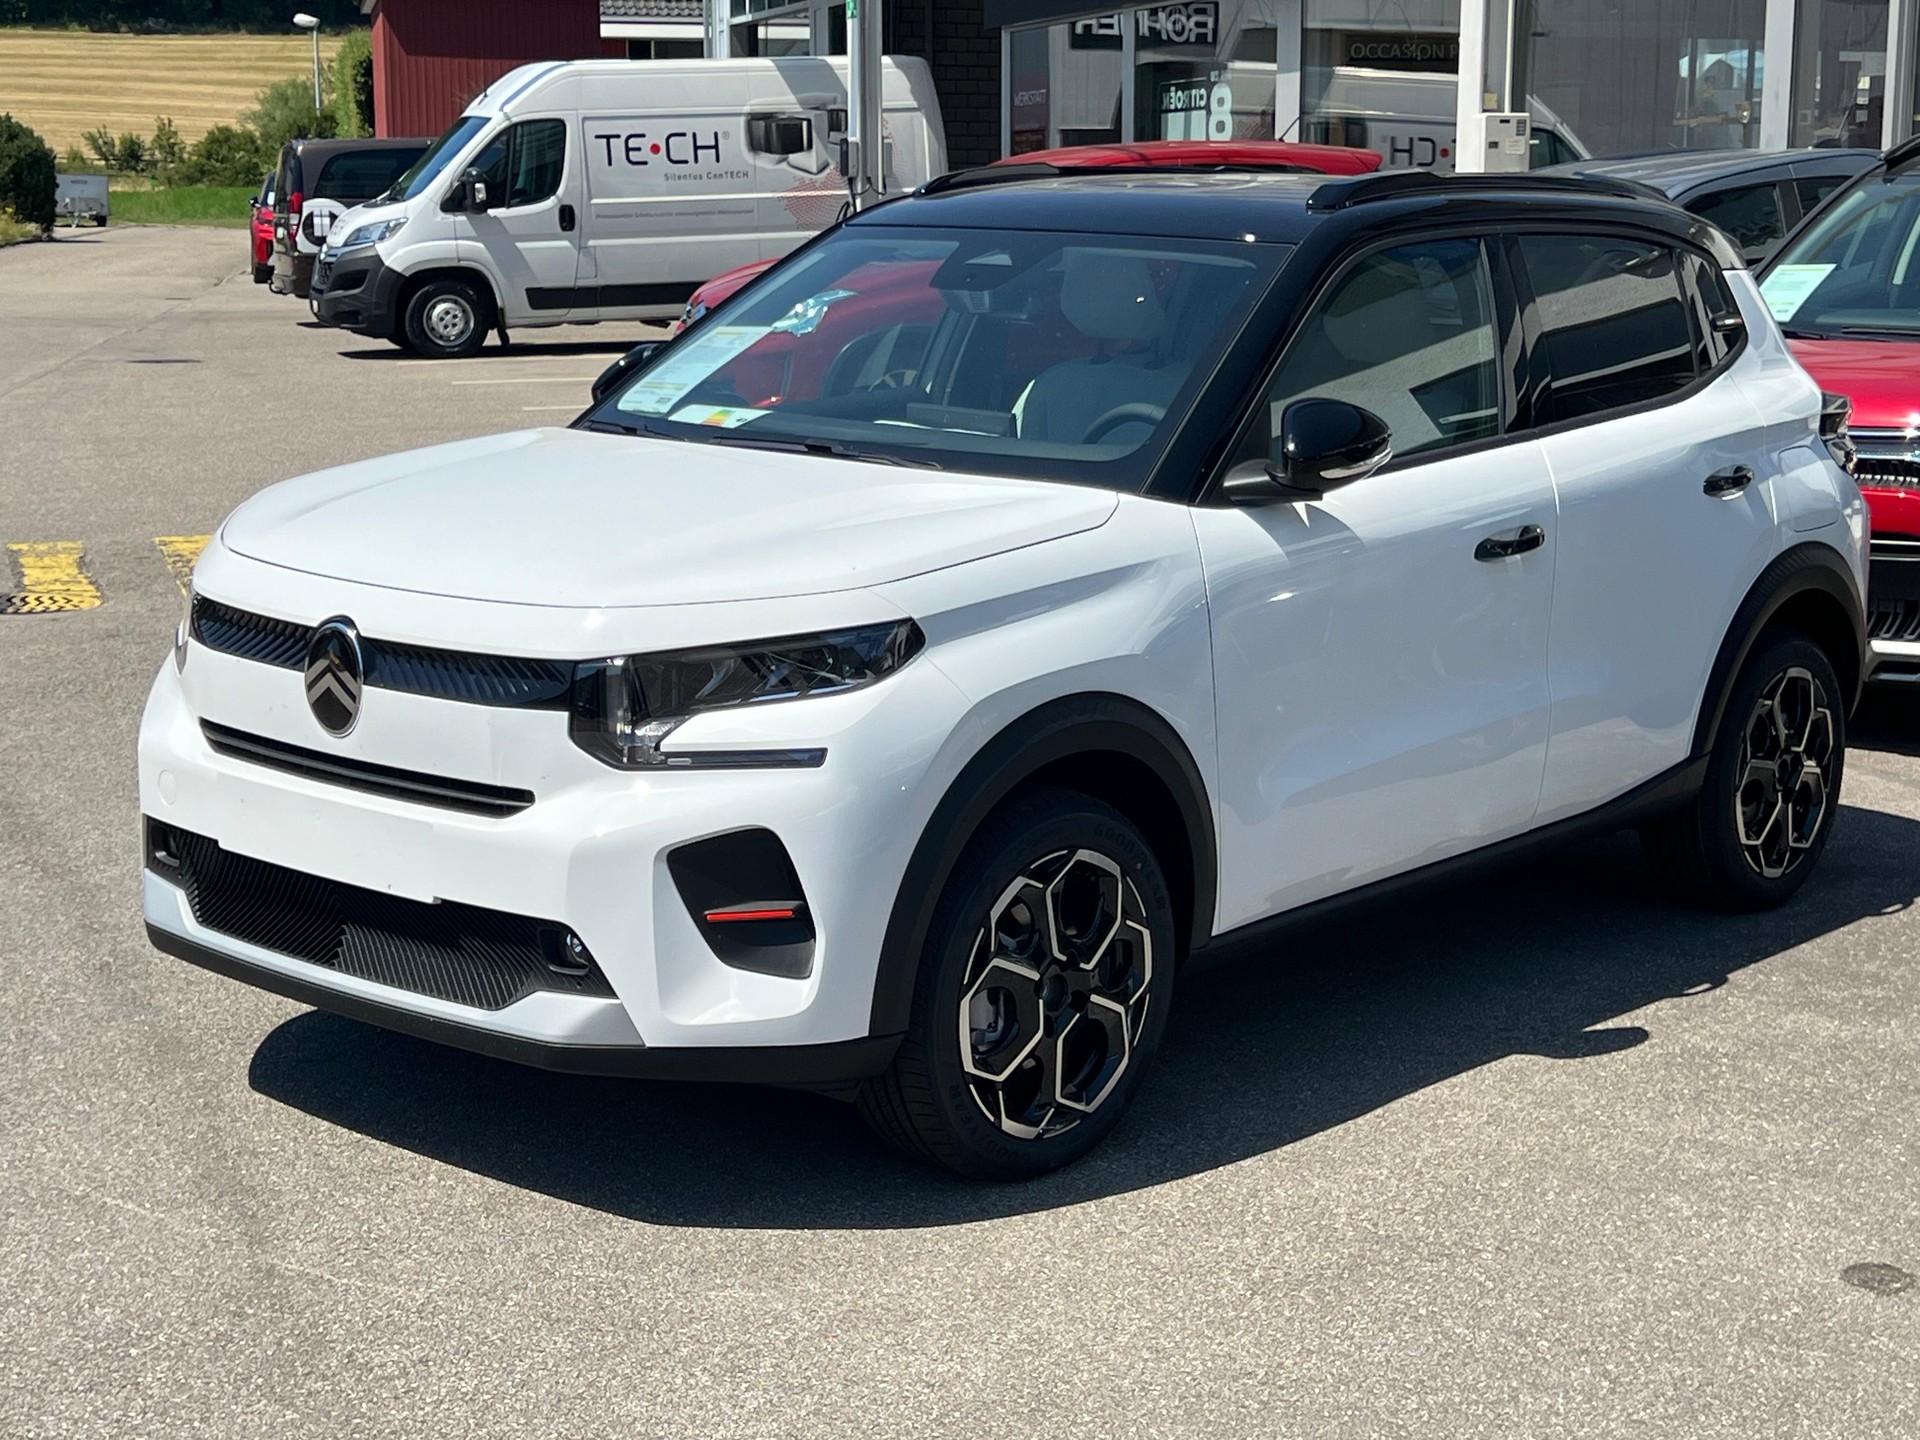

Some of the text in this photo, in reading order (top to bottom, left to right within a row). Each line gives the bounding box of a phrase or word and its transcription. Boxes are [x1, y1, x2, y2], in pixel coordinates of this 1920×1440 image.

[1350, 43, 1445, 59] OCCASION
[1014, 89, 1047, 107] WERKSTATT
[706, 170, 749, 180] ConTECH
